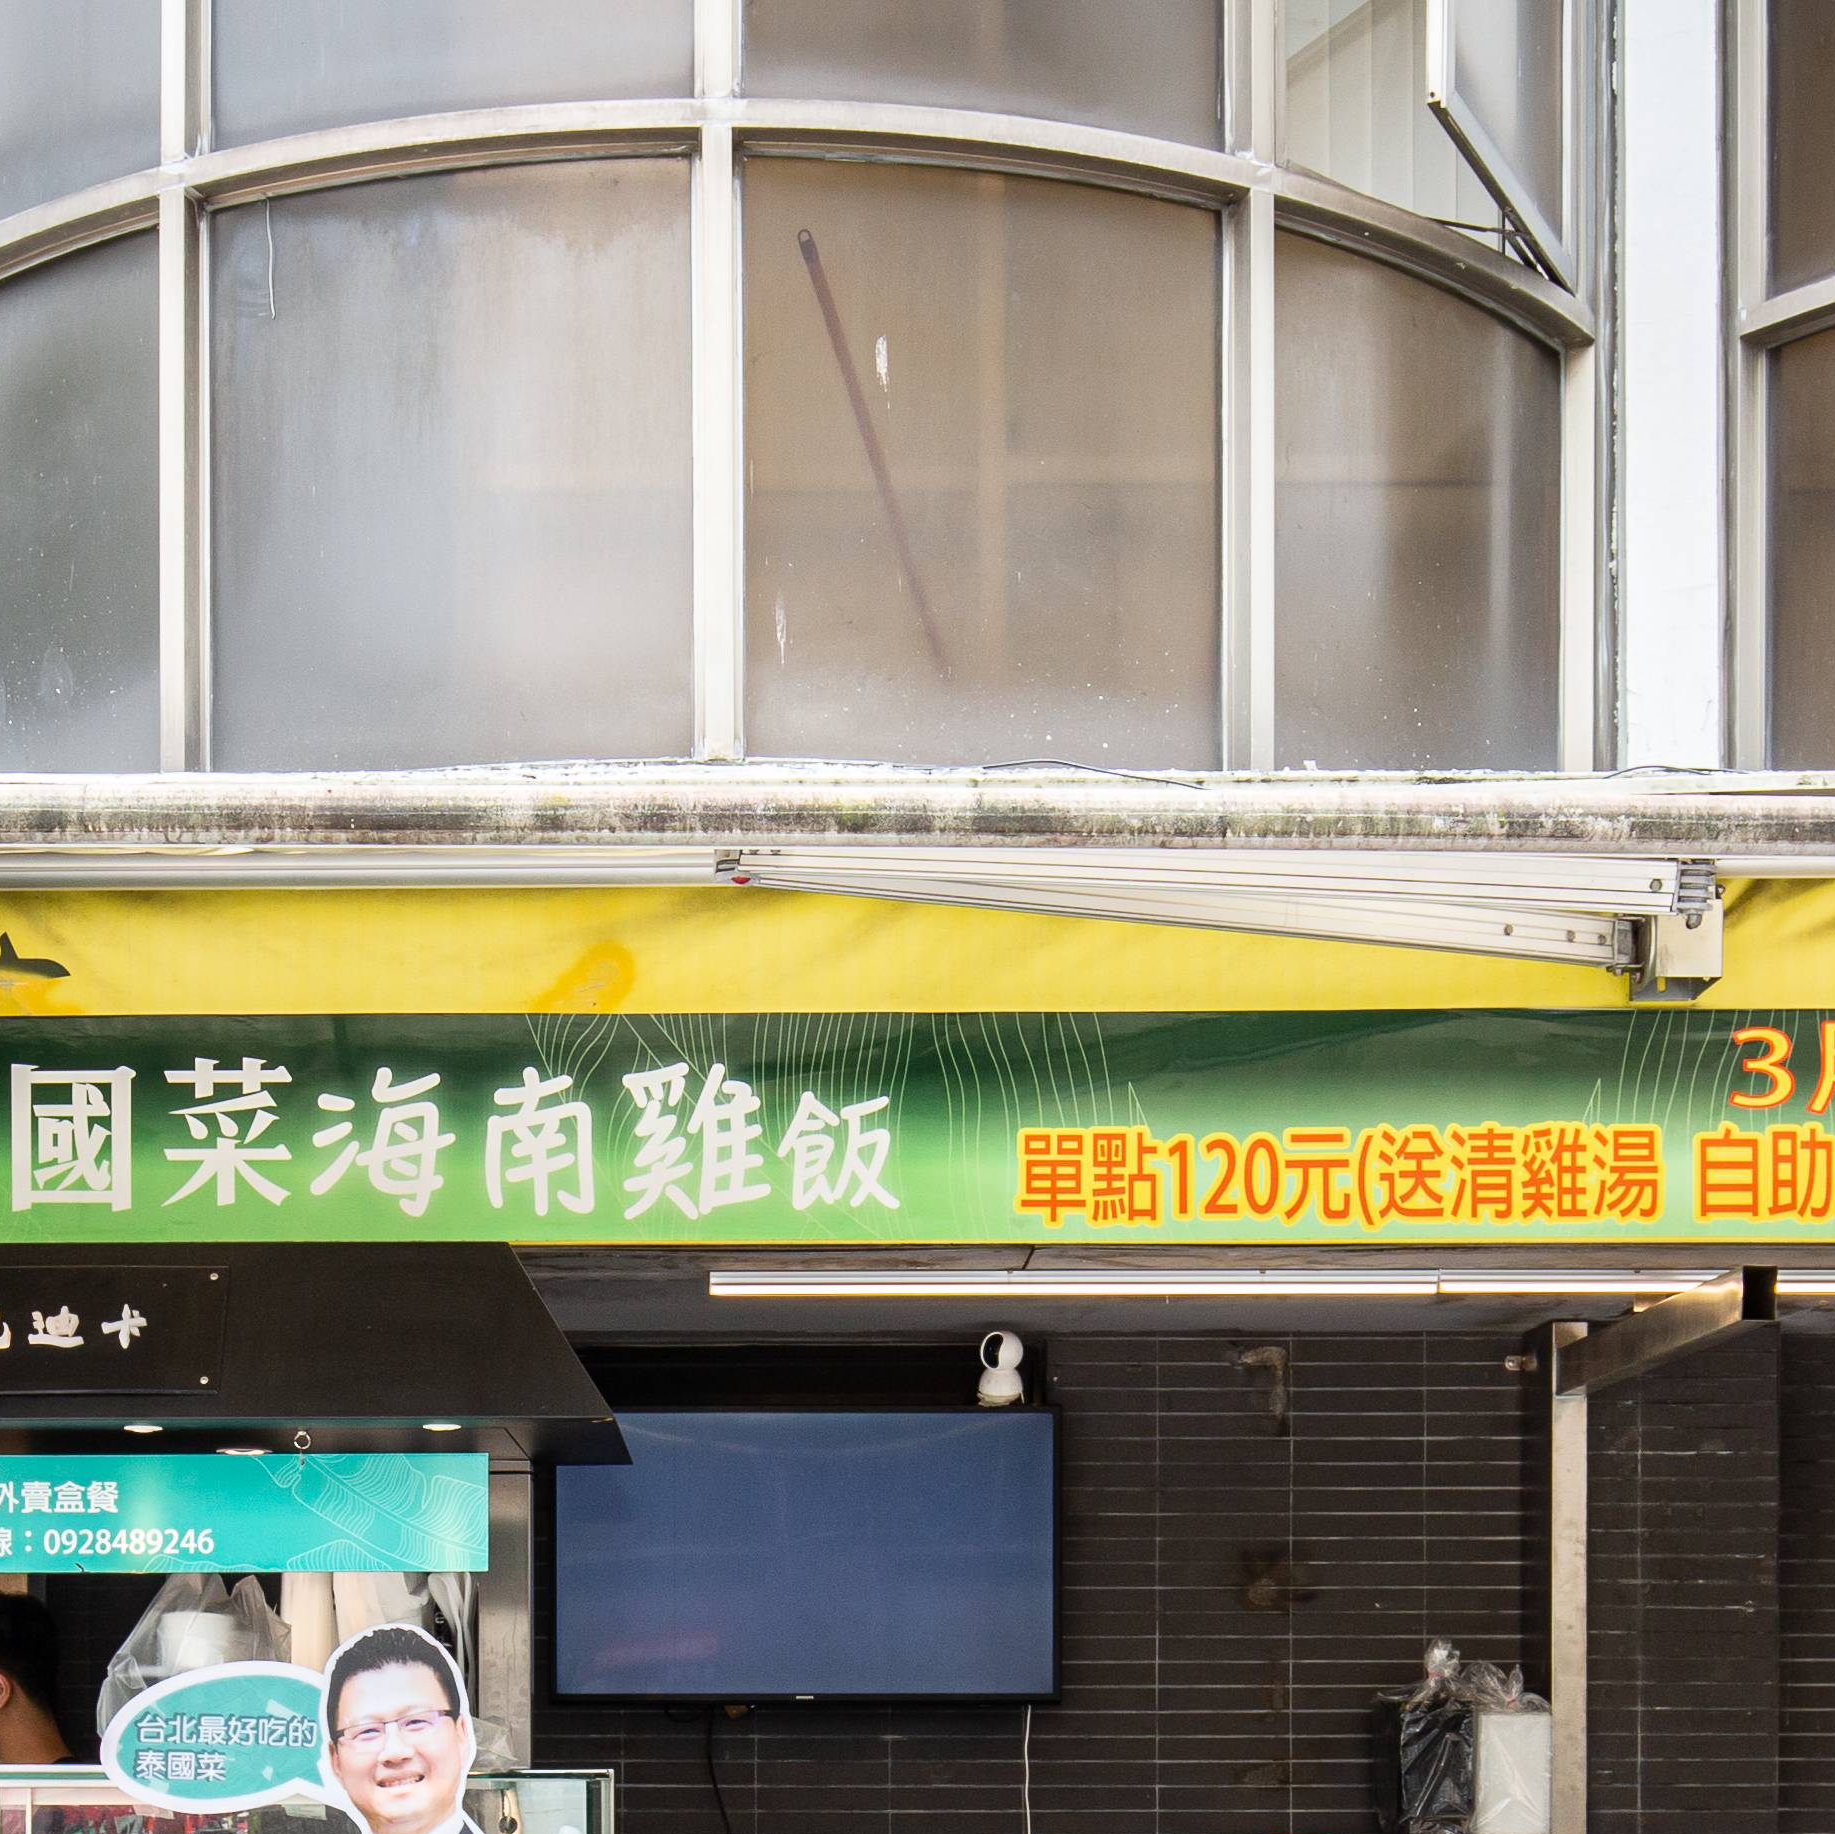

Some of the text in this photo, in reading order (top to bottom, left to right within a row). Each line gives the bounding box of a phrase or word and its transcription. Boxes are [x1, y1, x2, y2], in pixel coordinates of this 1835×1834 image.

[136, 1714, 317, 1747] 台北最好吃的
[135, 1750, 226, 1781] 泰國菜
